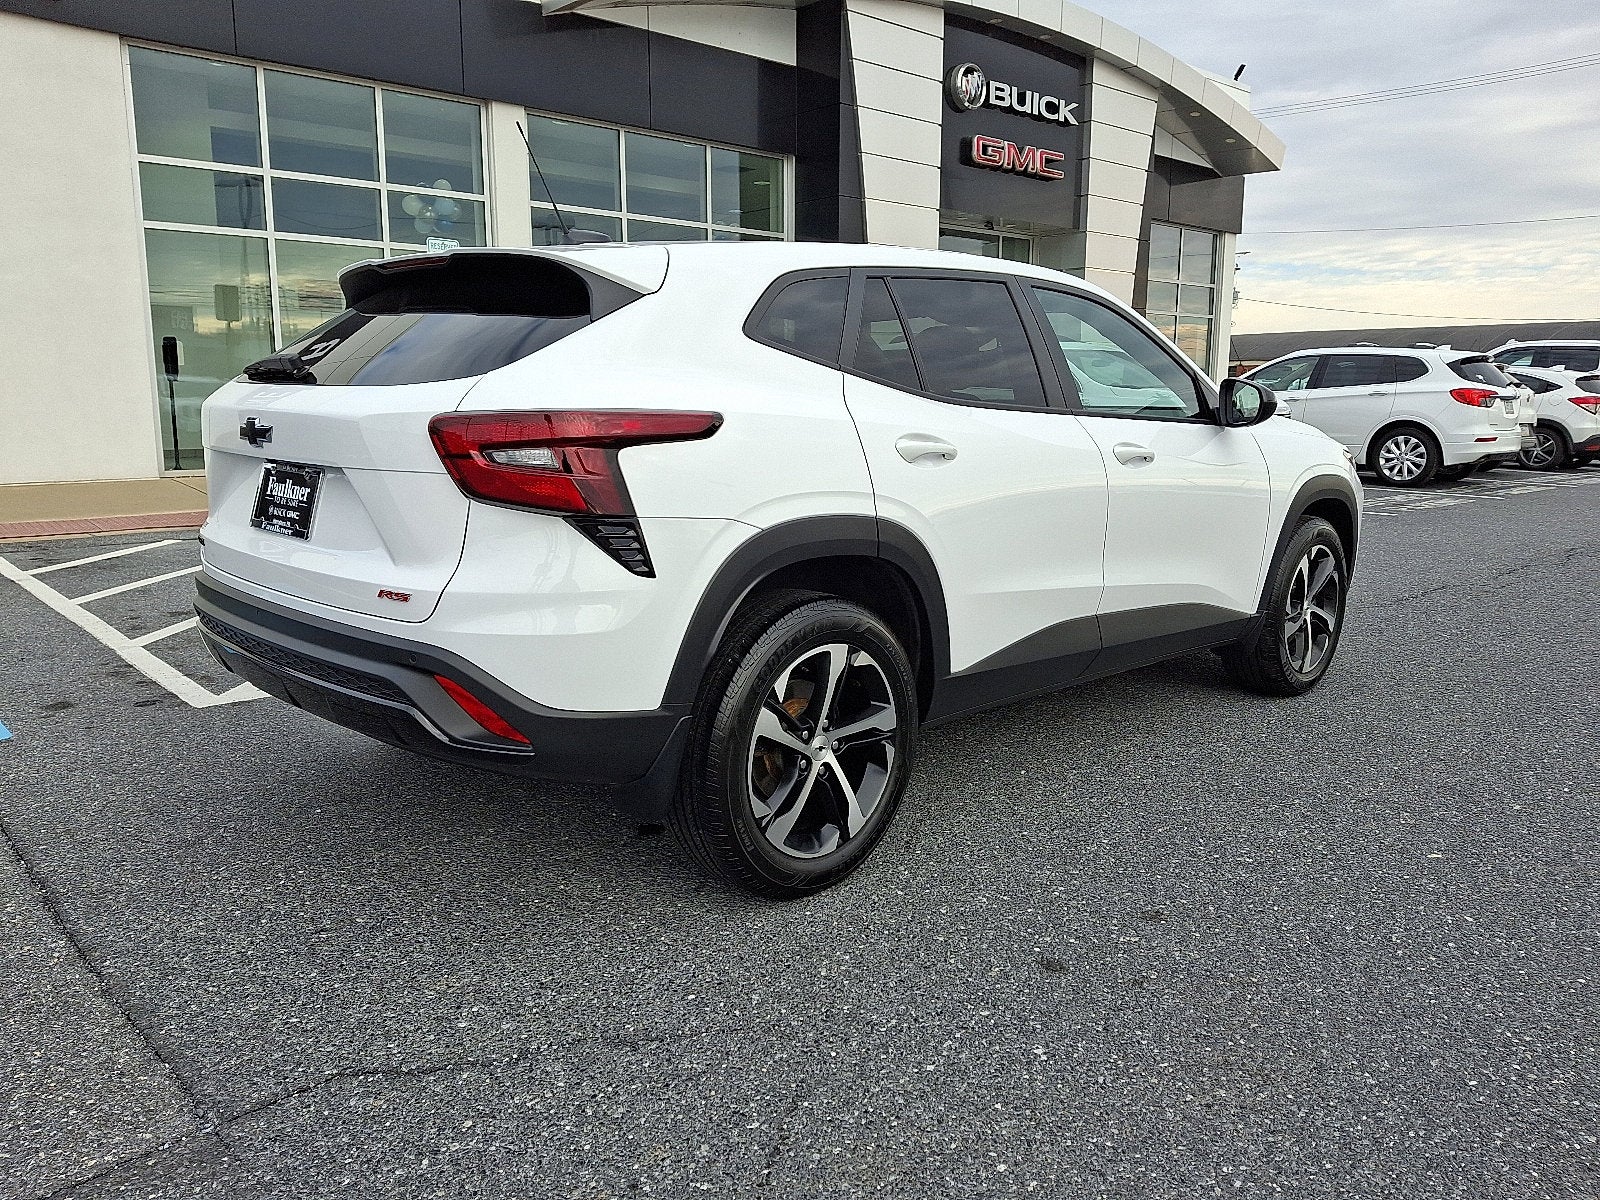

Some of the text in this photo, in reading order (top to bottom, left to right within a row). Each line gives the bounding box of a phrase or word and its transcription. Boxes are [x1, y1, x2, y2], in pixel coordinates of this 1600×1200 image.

[989, 80, 1079, 126] BUICK
[972, 134, 1064, 179] GMC
[266, 476, 311, 501] Faulkner
[261, 521, 294, 535] Faulkner
[377, 589, 412, 602] RS
